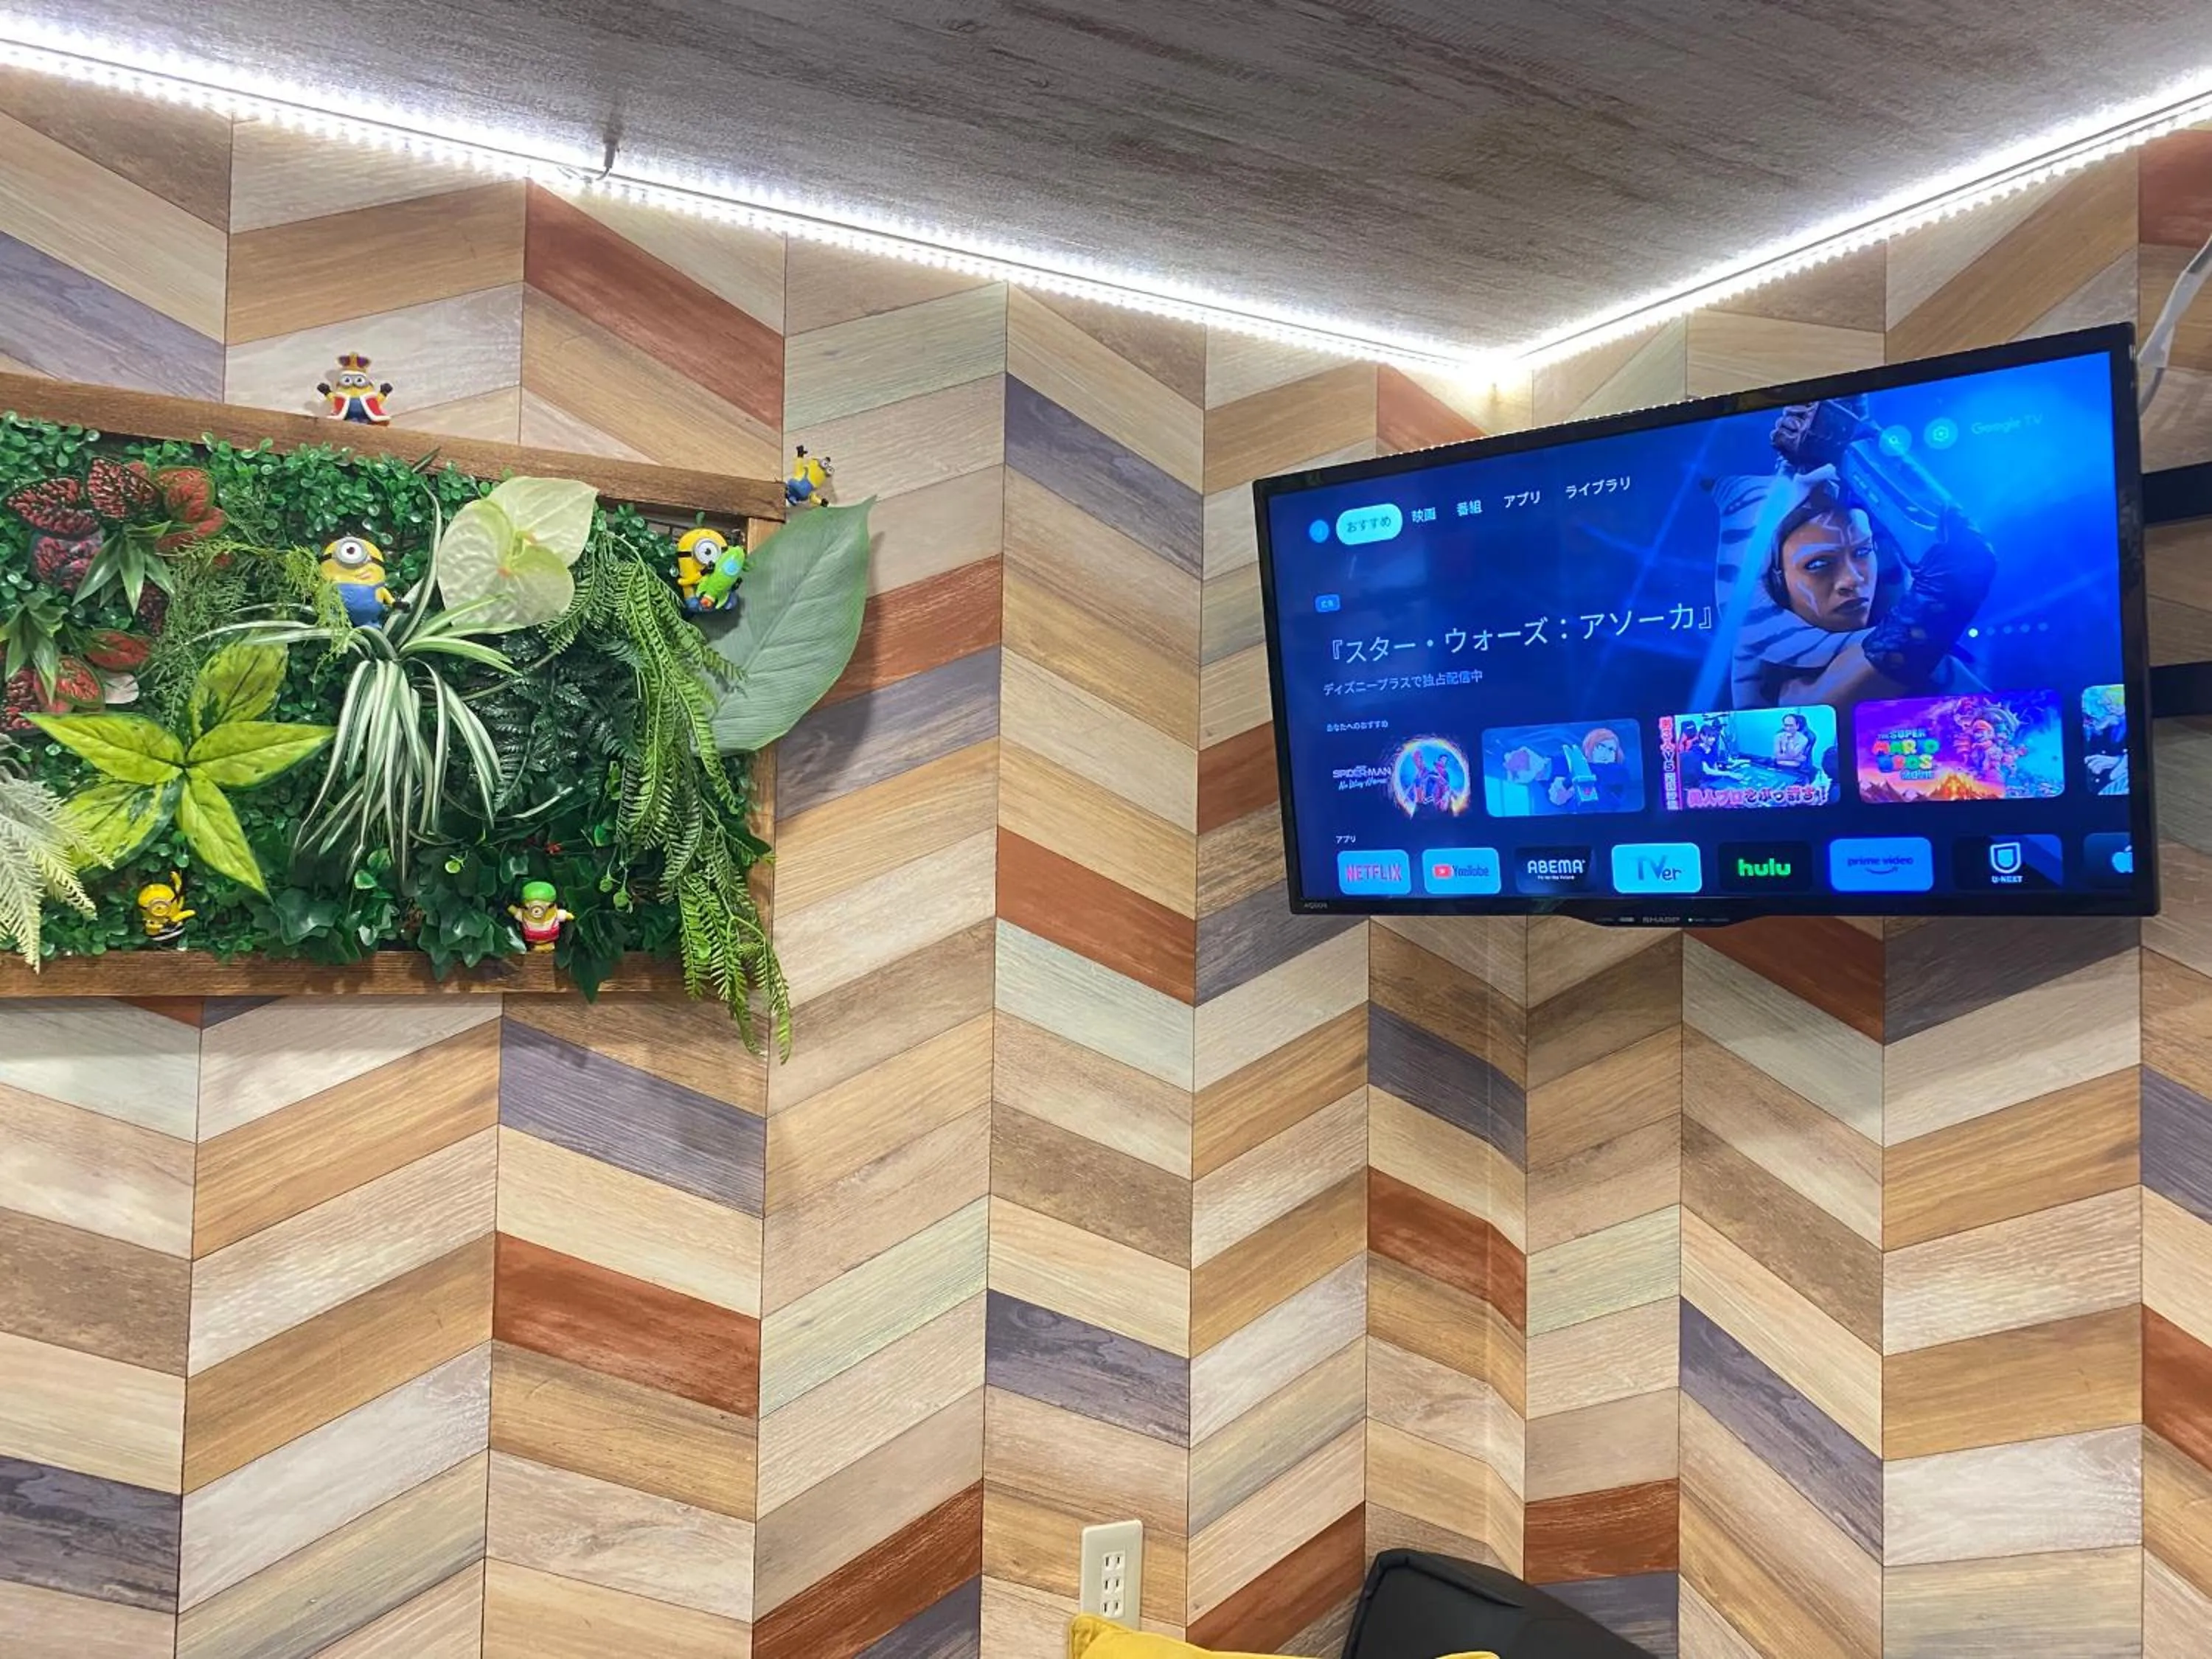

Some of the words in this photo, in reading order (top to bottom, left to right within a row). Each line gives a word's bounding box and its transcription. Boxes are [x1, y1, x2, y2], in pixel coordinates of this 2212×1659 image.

[1346, 515, 1391, 534] おすすめ
[1411, 507, 1437, 523] 映画
[1457, 499, 1482, 516] 番組
[1504, 490, 1541, 508] アプリ
[1565, 476, 1631, 499] ライブラリ
[1324, 669, 1484, 696] ディズニープラスで独占配信中
[1335, 835, 1356, 844] アプリ
[1527, 859, 1584, 874] ABEMA
[1632, 855, 1682, 881] TVer
[1738, 858, 1791, 876] hulu
[1847, 856, 1880, 866] prime
[1882, 854, 1914, 865] video
[1346, 863, 1402, 883] NETFLIX
